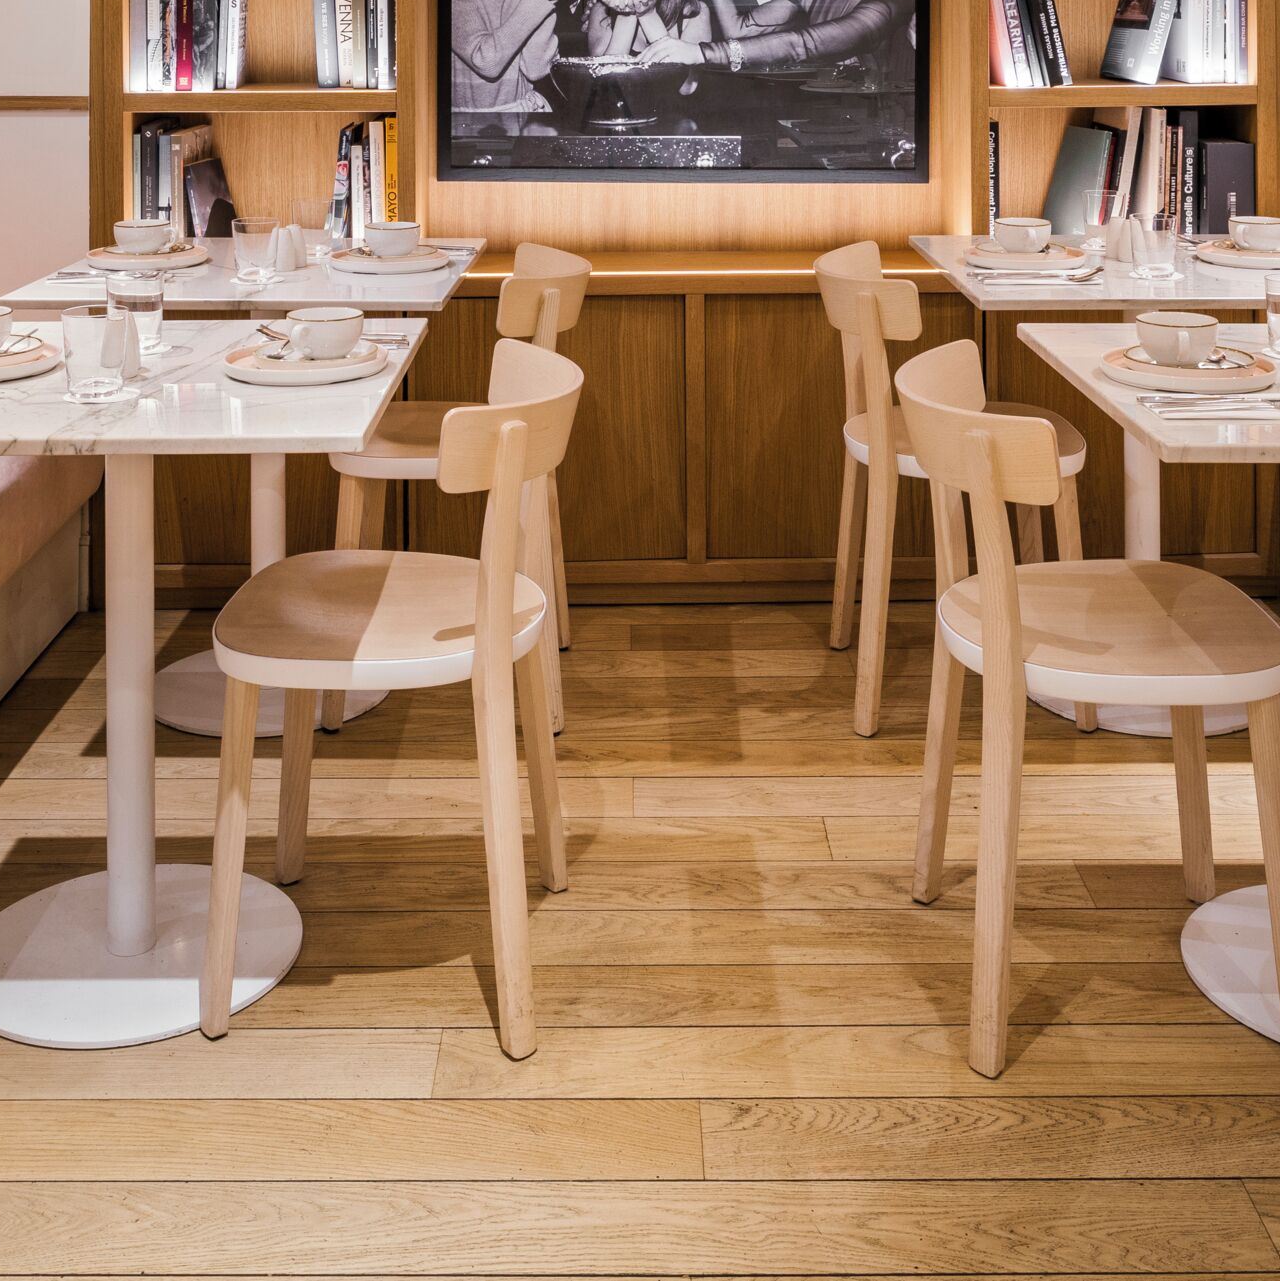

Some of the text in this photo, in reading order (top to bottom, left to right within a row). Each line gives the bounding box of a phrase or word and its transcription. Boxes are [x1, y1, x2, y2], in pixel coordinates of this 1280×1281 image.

[1005, 2, 1023, 47] LEARN
[1044, 34, 1053, 59] NICOLAS
[1148, 13, 1170, 55] Working
[1160, 0, 1170, 10] in
[1052, 28, 1069, 77] Afrikanische
[1184, 147, 1194, 193] Culture[s]
[388, 191, 397, 222] MAYO
